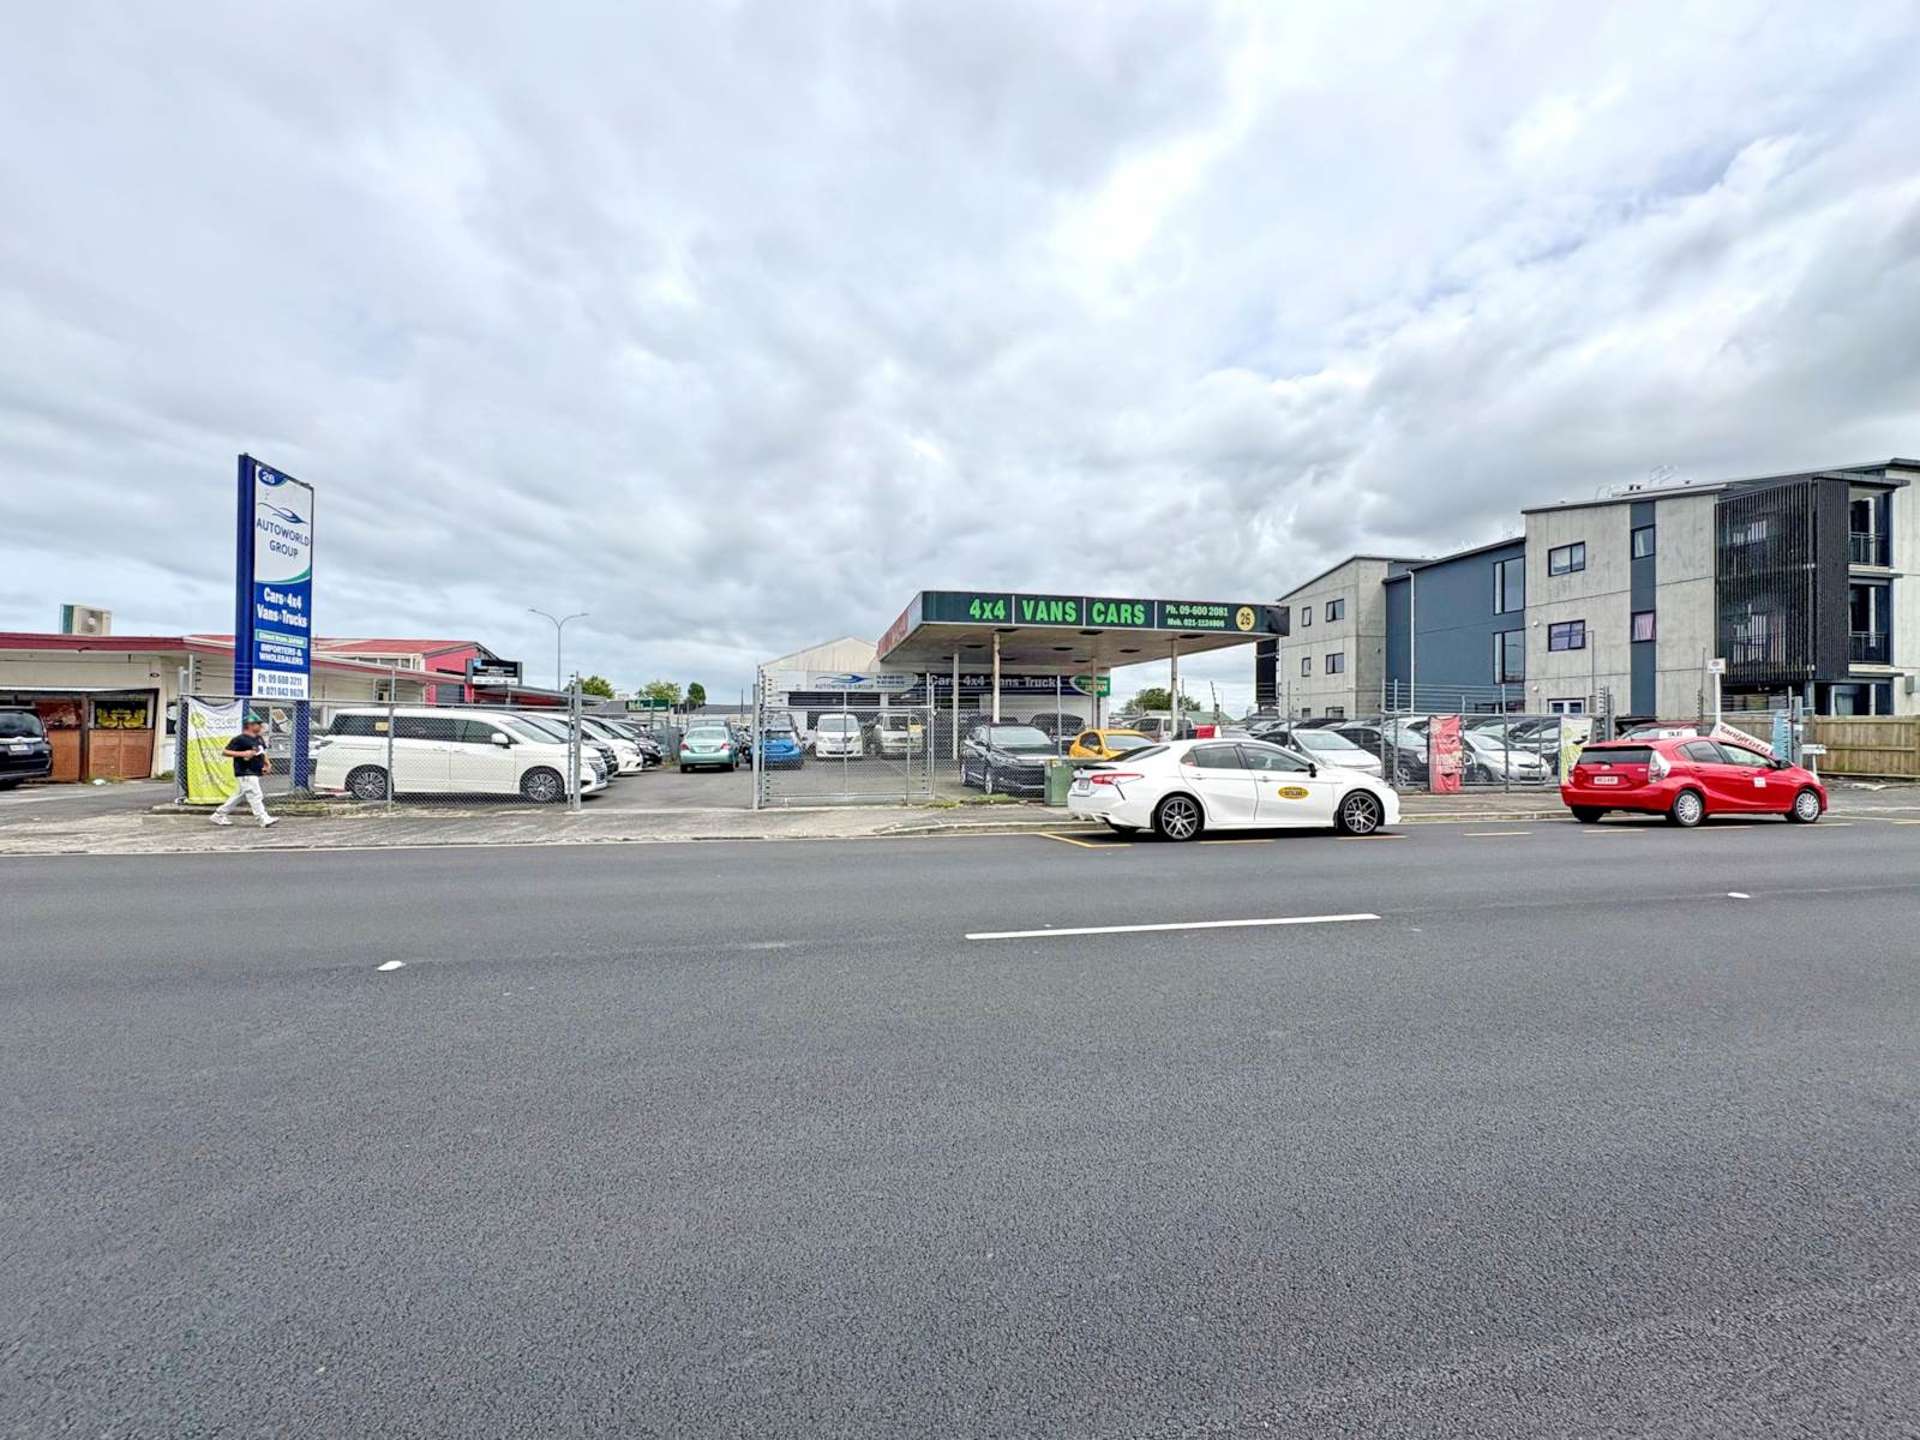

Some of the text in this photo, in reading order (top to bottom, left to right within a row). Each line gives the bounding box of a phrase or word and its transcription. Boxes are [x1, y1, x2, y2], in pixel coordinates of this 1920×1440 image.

[256, 518, 310, 546] AUTOWORLD
[269, 540, 299, 557] GROUP
[968, 599, 1146, 625] 4x4 VANS CARS
[1239, 612, 1252, 627] 26
[929, 676, 955, 686] Car
[962, 677, 985, 686] 4x4
